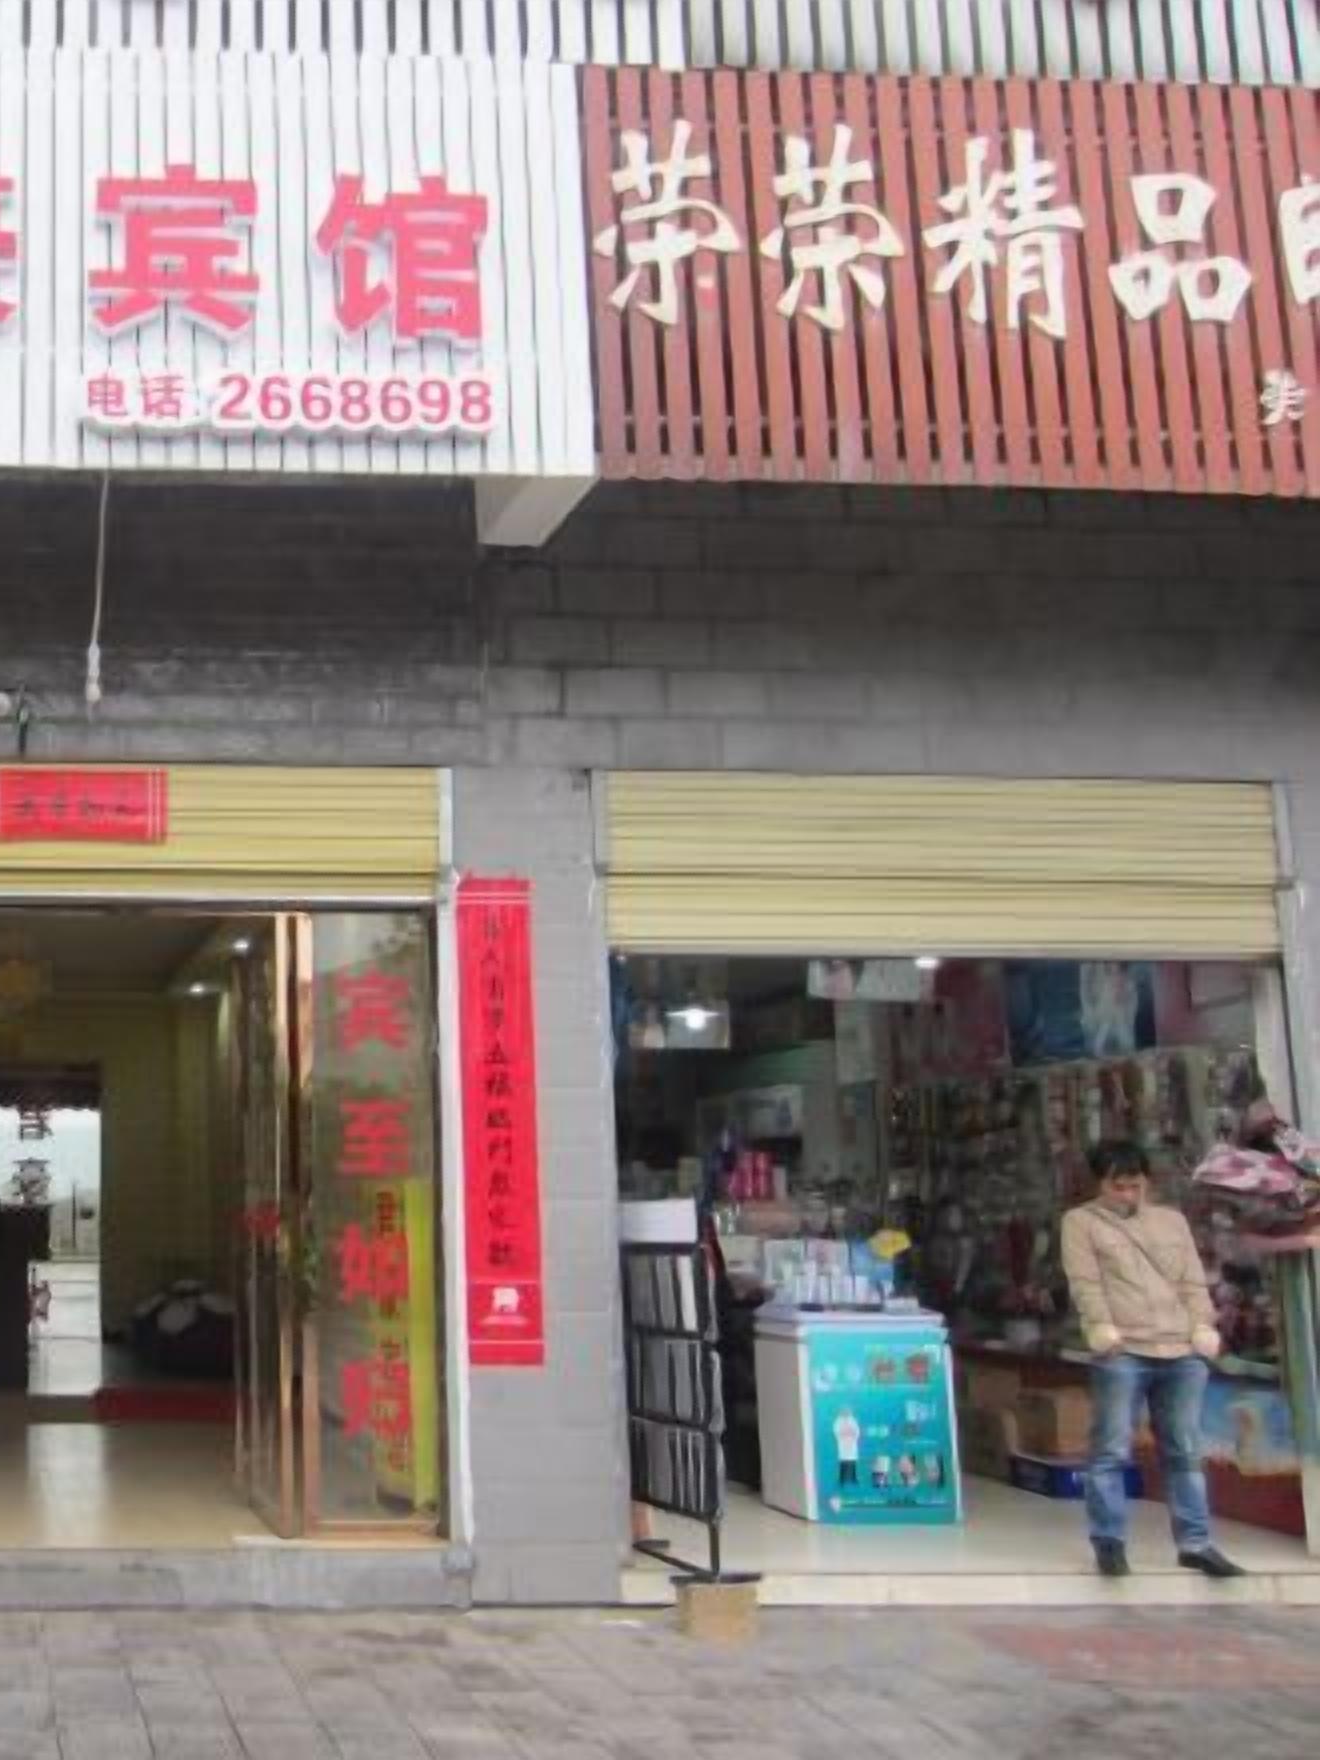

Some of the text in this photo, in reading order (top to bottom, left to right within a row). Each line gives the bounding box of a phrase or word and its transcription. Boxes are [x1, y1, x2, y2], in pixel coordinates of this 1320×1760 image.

[593, 119, 1320, 338] 荣荣精品
[217, 372, 492, 425] 2668698
